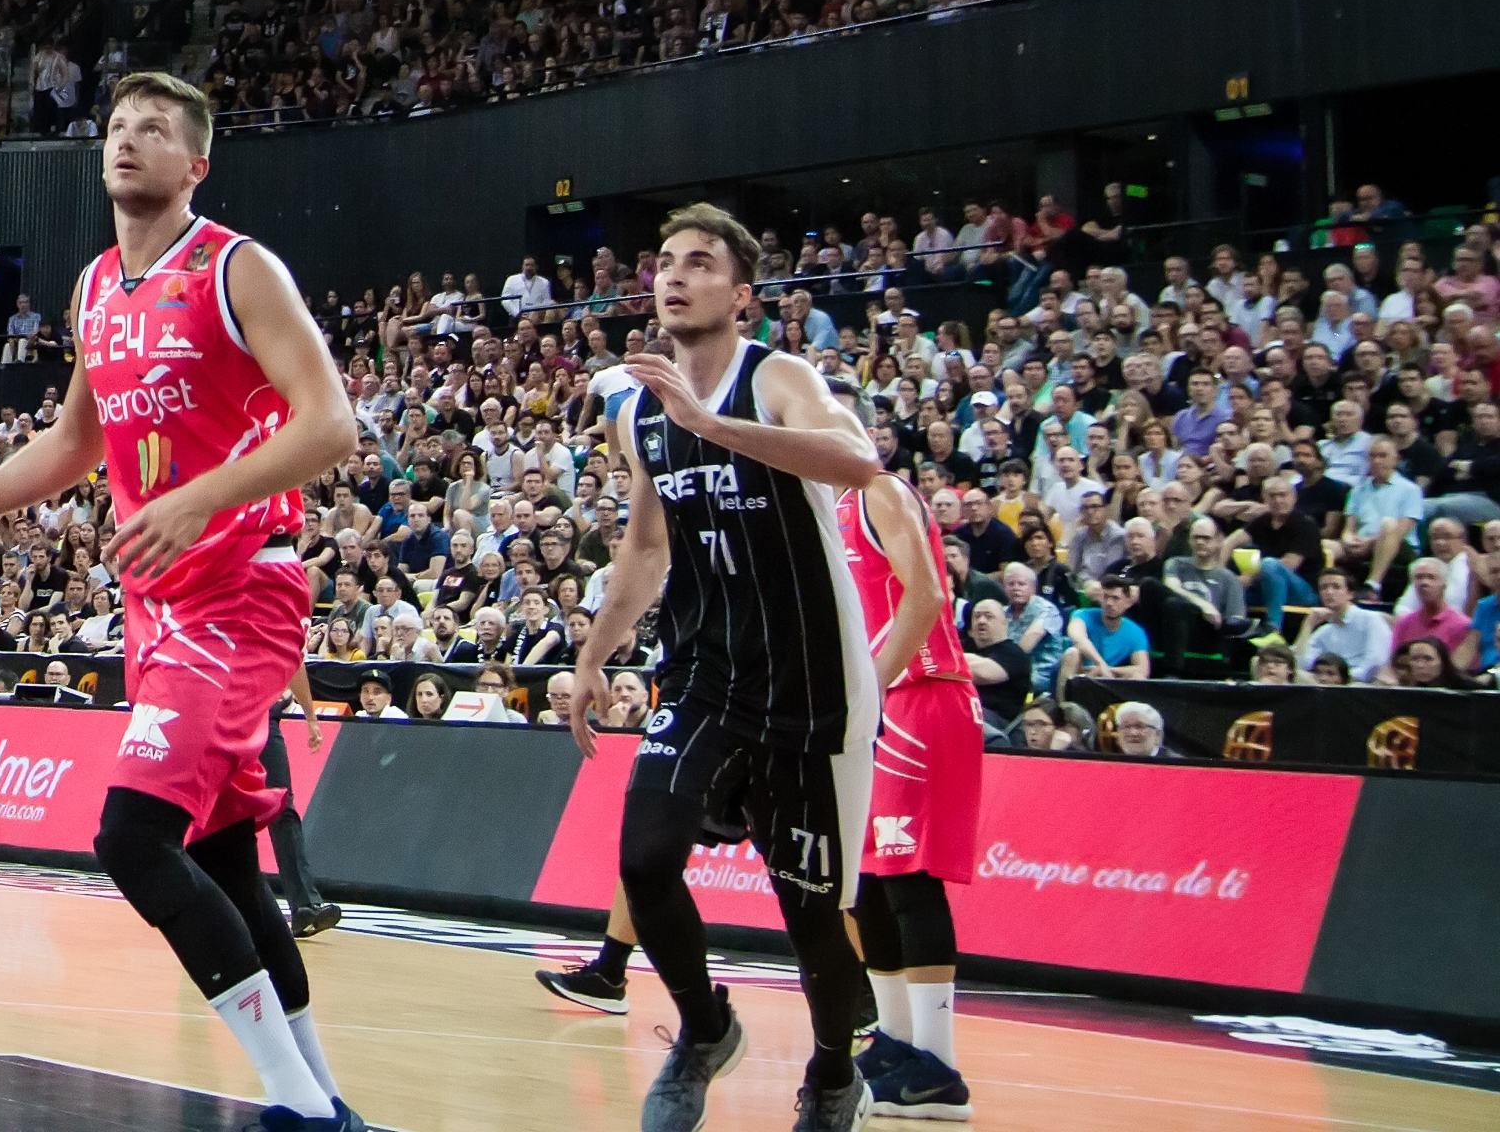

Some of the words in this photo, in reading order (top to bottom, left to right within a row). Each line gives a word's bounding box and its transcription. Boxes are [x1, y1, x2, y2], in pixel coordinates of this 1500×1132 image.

[110, 312, 145, 362] 24
[653, 463, 739, 500] RETA
[699, 529, 737, 575] 71
[790, 827, 830, 878] 71
[978, 841, 1089, 891] Siempre
[1092, 867, 1169, 892] cerca
[1173, 860, 1213, 896] de
[1216, 867, 1250, 899] ti
